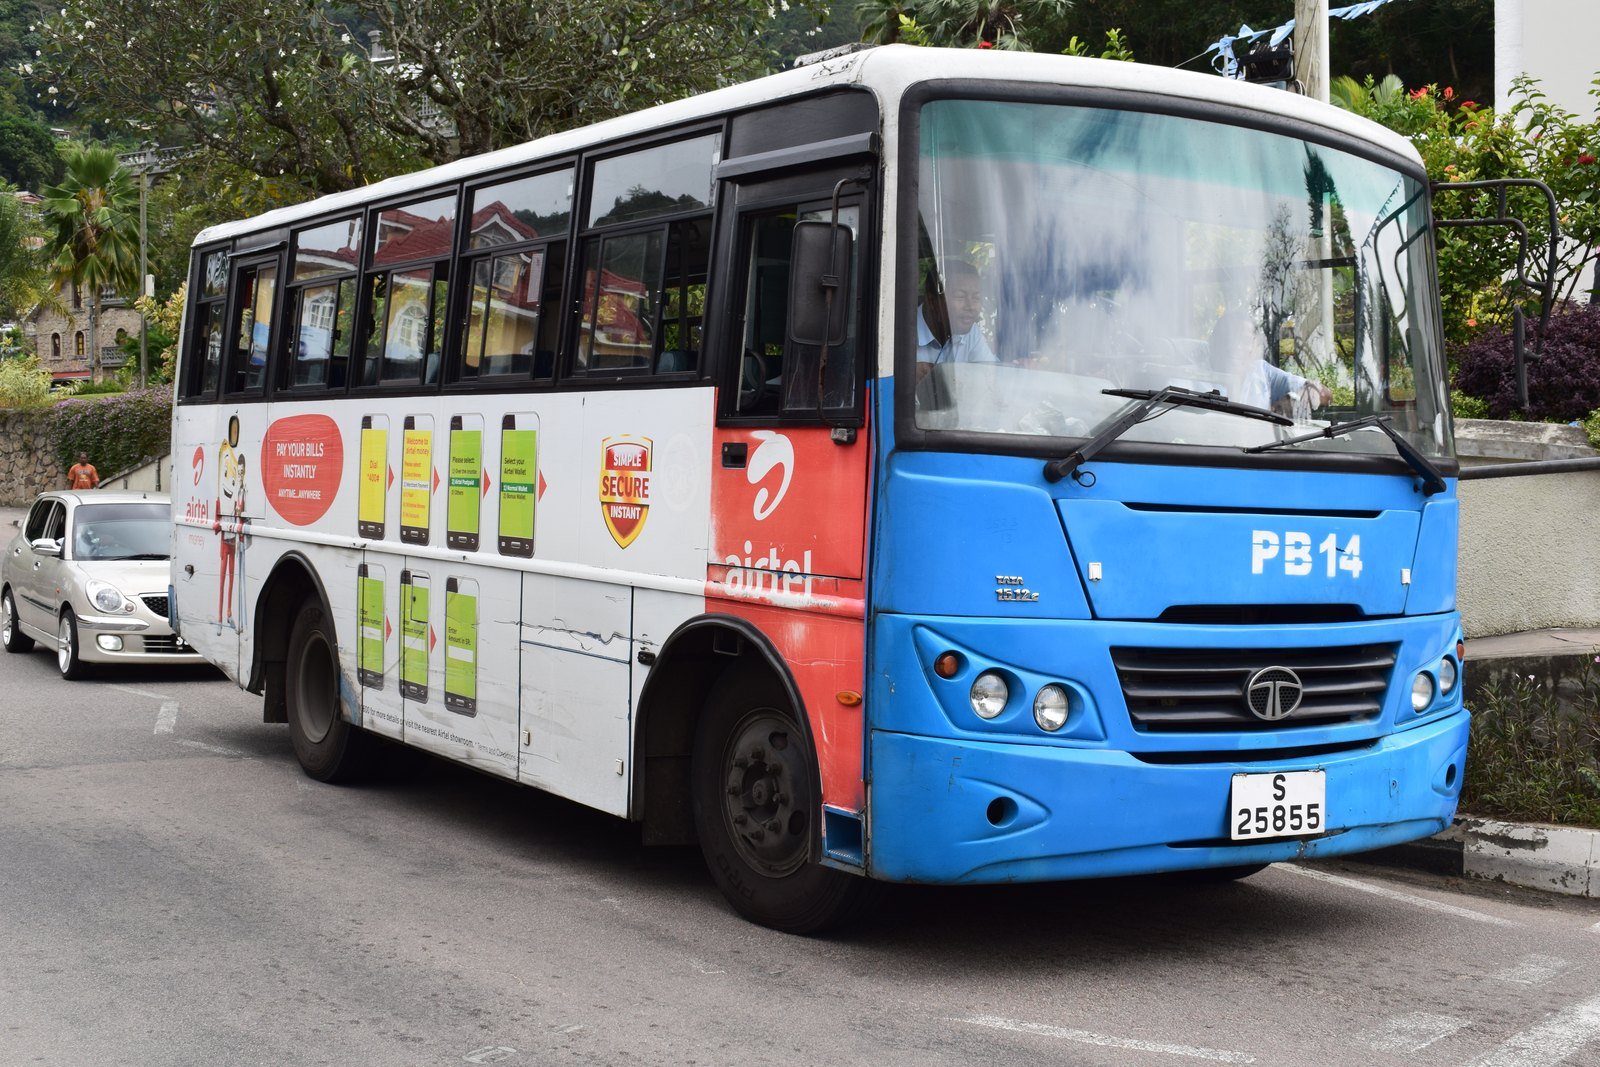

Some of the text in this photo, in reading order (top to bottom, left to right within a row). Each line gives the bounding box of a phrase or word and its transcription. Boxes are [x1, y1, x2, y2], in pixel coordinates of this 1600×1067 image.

[276, 442, 324, 457] PAY YOUR BILLS
[504, 457, 516, 465] Select
[613, 453, 641, 467] SIMPLE
[283, 464, 317, 479] INSTANTLY
[601, 475, 650, 499] SECURE
[186, 496, 209, 524] airtel
[610, 505, 641, 520] INSTANT
[724, 540, 812, 599] airtel
[995, 575, 1024, 585] TATA
[376, 711, 386, 720] more
[386, 712, 400, 725] details
[421, 725, 437, 736] nearest
[438, 728, 449, 739] Airtel
[1272, 774, 1286, 801] S
[1237, 803, 1320, 835] 25855
